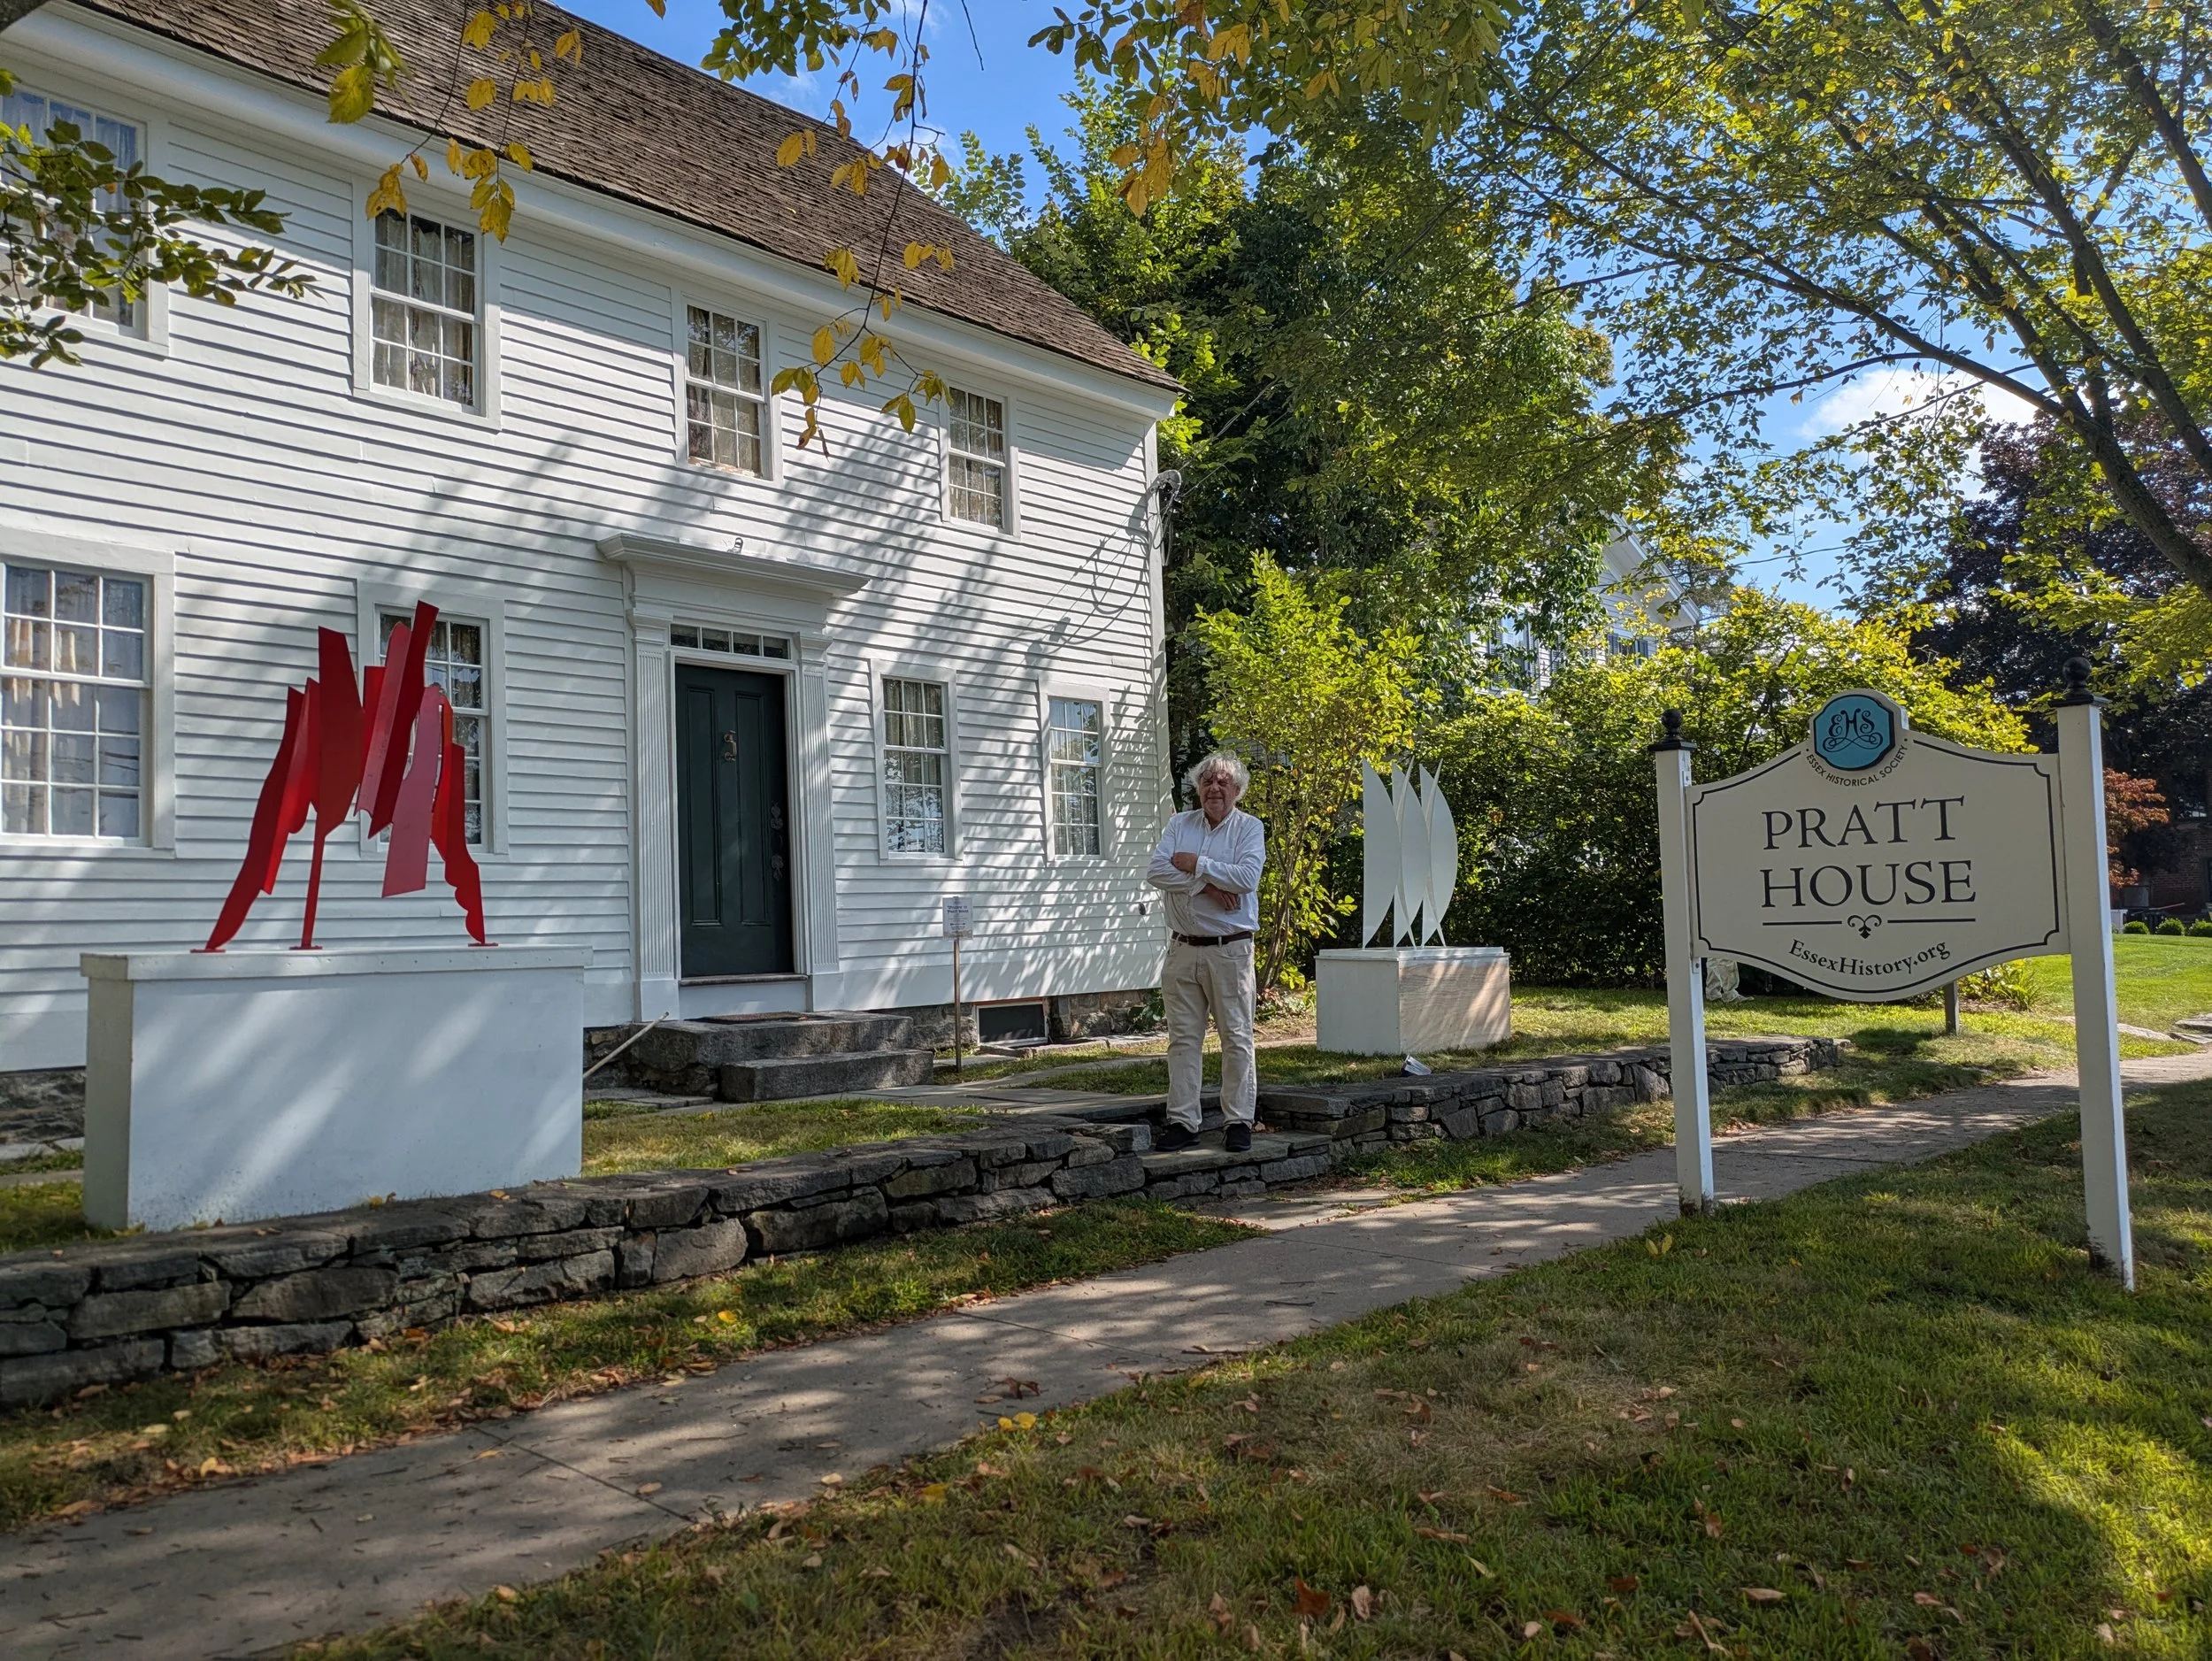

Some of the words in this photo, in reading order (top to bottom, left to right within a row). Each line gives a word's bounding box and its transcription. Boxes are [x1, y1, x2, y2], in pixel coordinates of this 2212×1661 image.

[1806, 754, 1827, 777] ESSEX
[1825, 773, 1880, 787] HISTORICAL
[1879, 744, 1909, 779] SOCIETY
[1761, 795, 1965, 850] PRATT
[1760, 859, 1977, 909] HOUSE
[1788, 938, 1952, 976] EssexHistory.org
